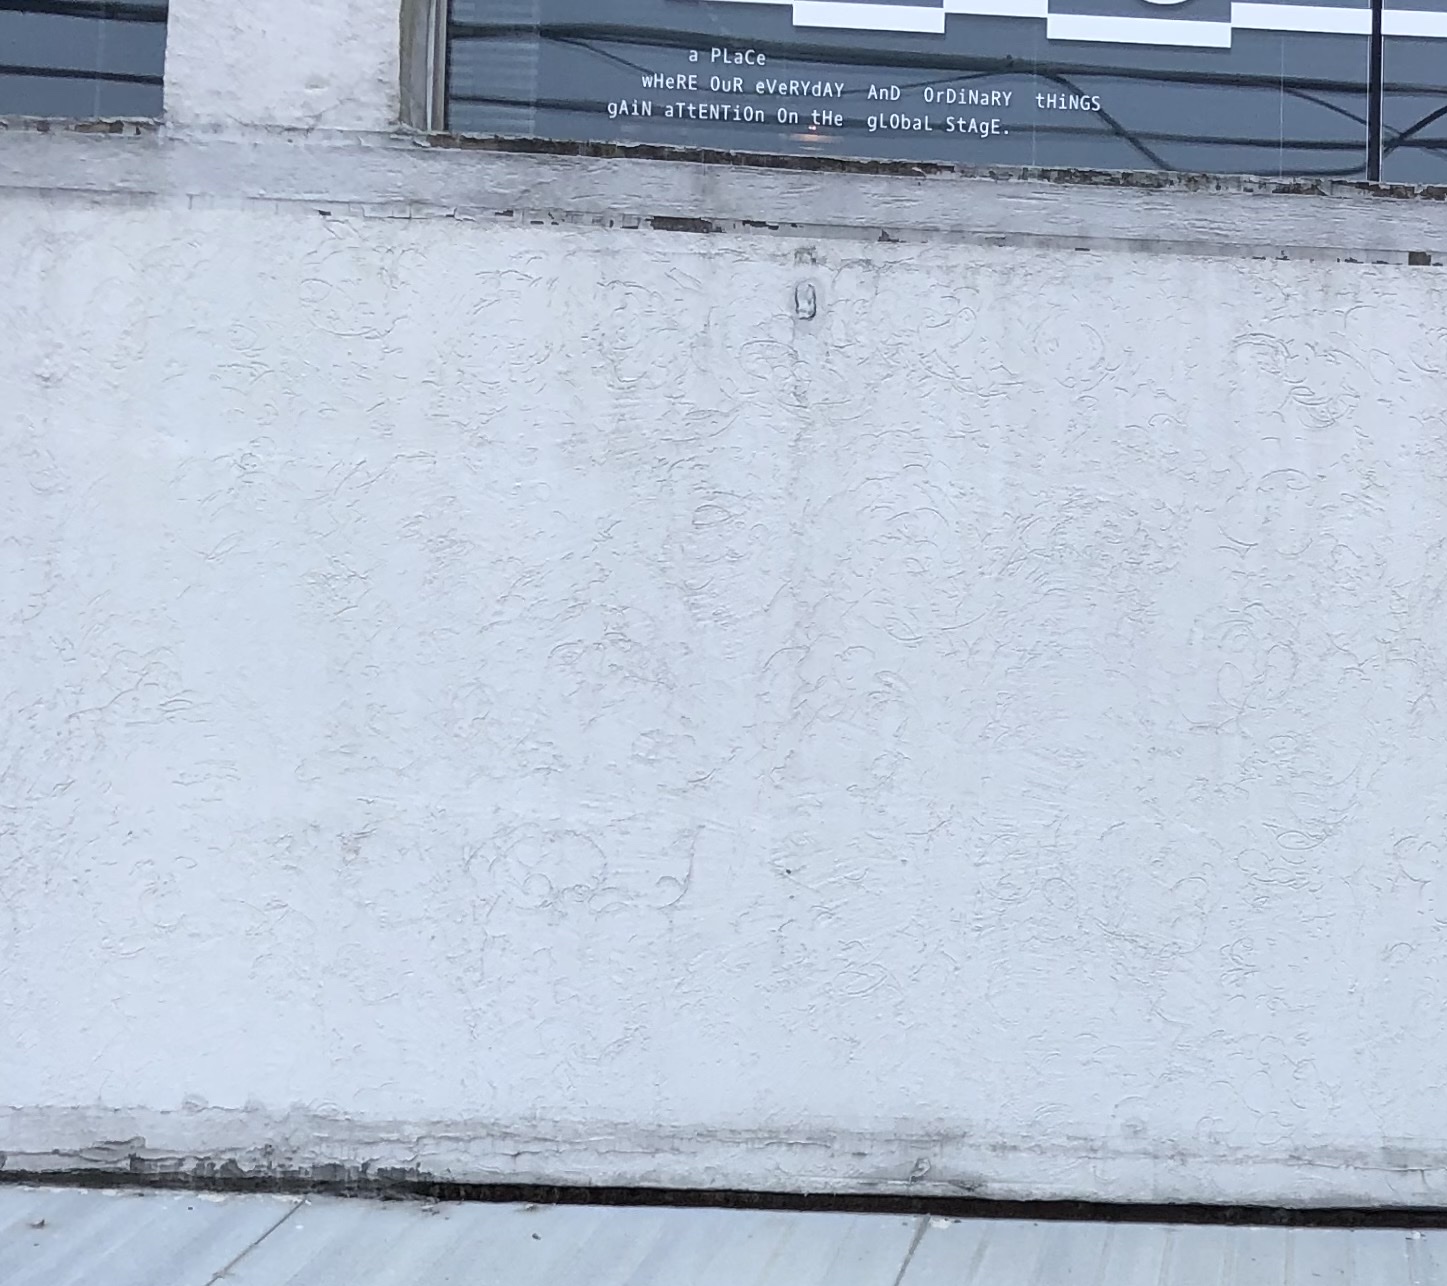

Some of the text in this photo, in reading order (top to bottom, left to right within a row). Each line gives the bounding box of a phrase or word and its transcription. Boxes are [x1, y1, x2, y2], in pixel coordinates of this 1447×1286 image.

[688, 47, 767, 66] a PLaCe
[641, 72, 844, 98] wHeRE OuR eVeRYdAY
[867, 84, 1101, 112] AnD OrDiNaRY tHiNGS
[607, 100, 1010, 138] gAiN aTtENTiOn On tHe gLObaL StAgE.
